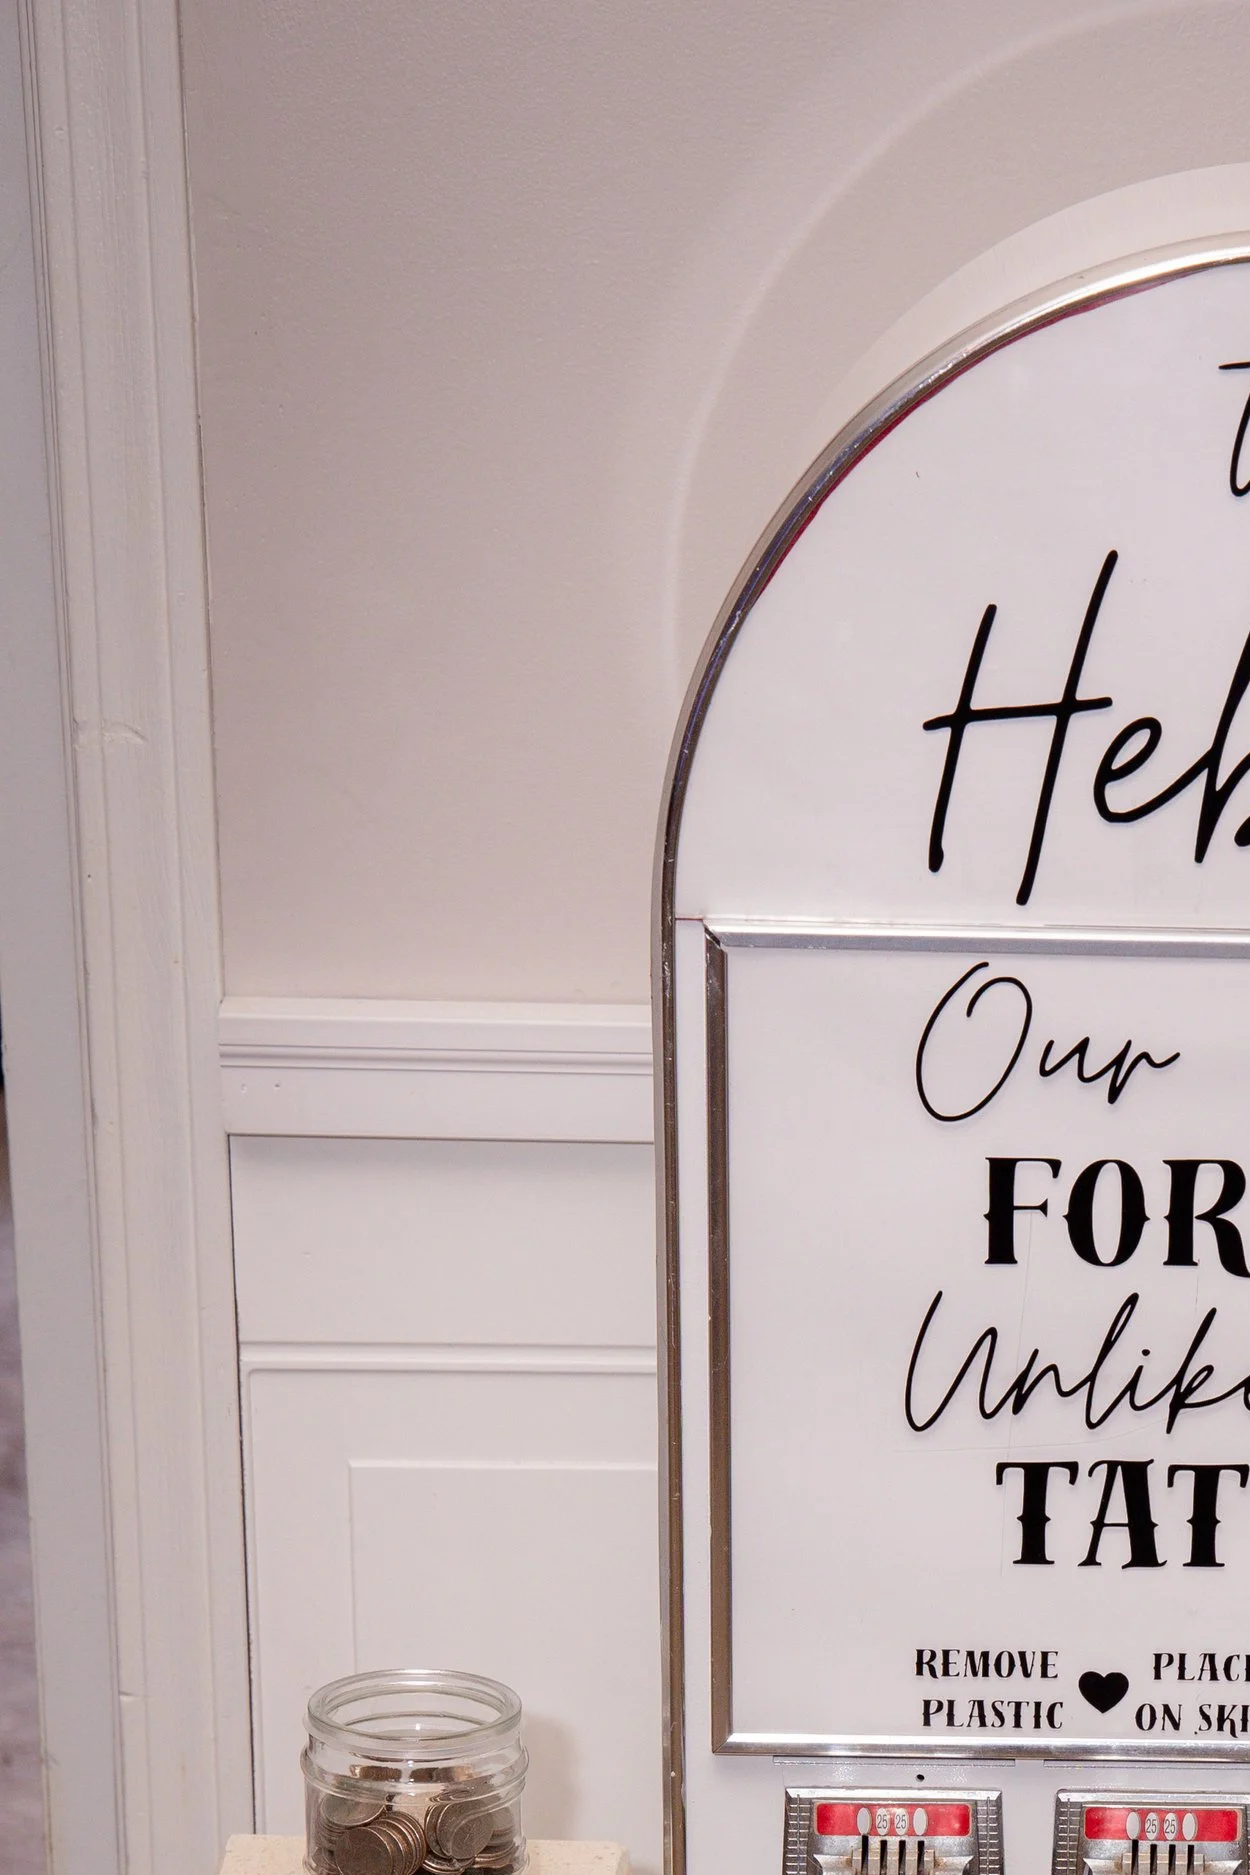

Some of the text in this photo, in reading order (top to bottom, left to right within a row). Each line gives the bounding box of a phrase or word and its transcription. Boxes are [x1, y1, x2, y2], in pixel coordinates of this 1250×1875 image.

[915, 961, 1181, 1123] Our
[915, 1648, 1060, 1680] REMOVE
[921, 1699, 1065, 1730] PLASTIC
[1134, 1703, 1183, 1734] ON
[876, 1814, 907, 1830] 25 25
[1145, 1818, 1176, 1834] 25 25
